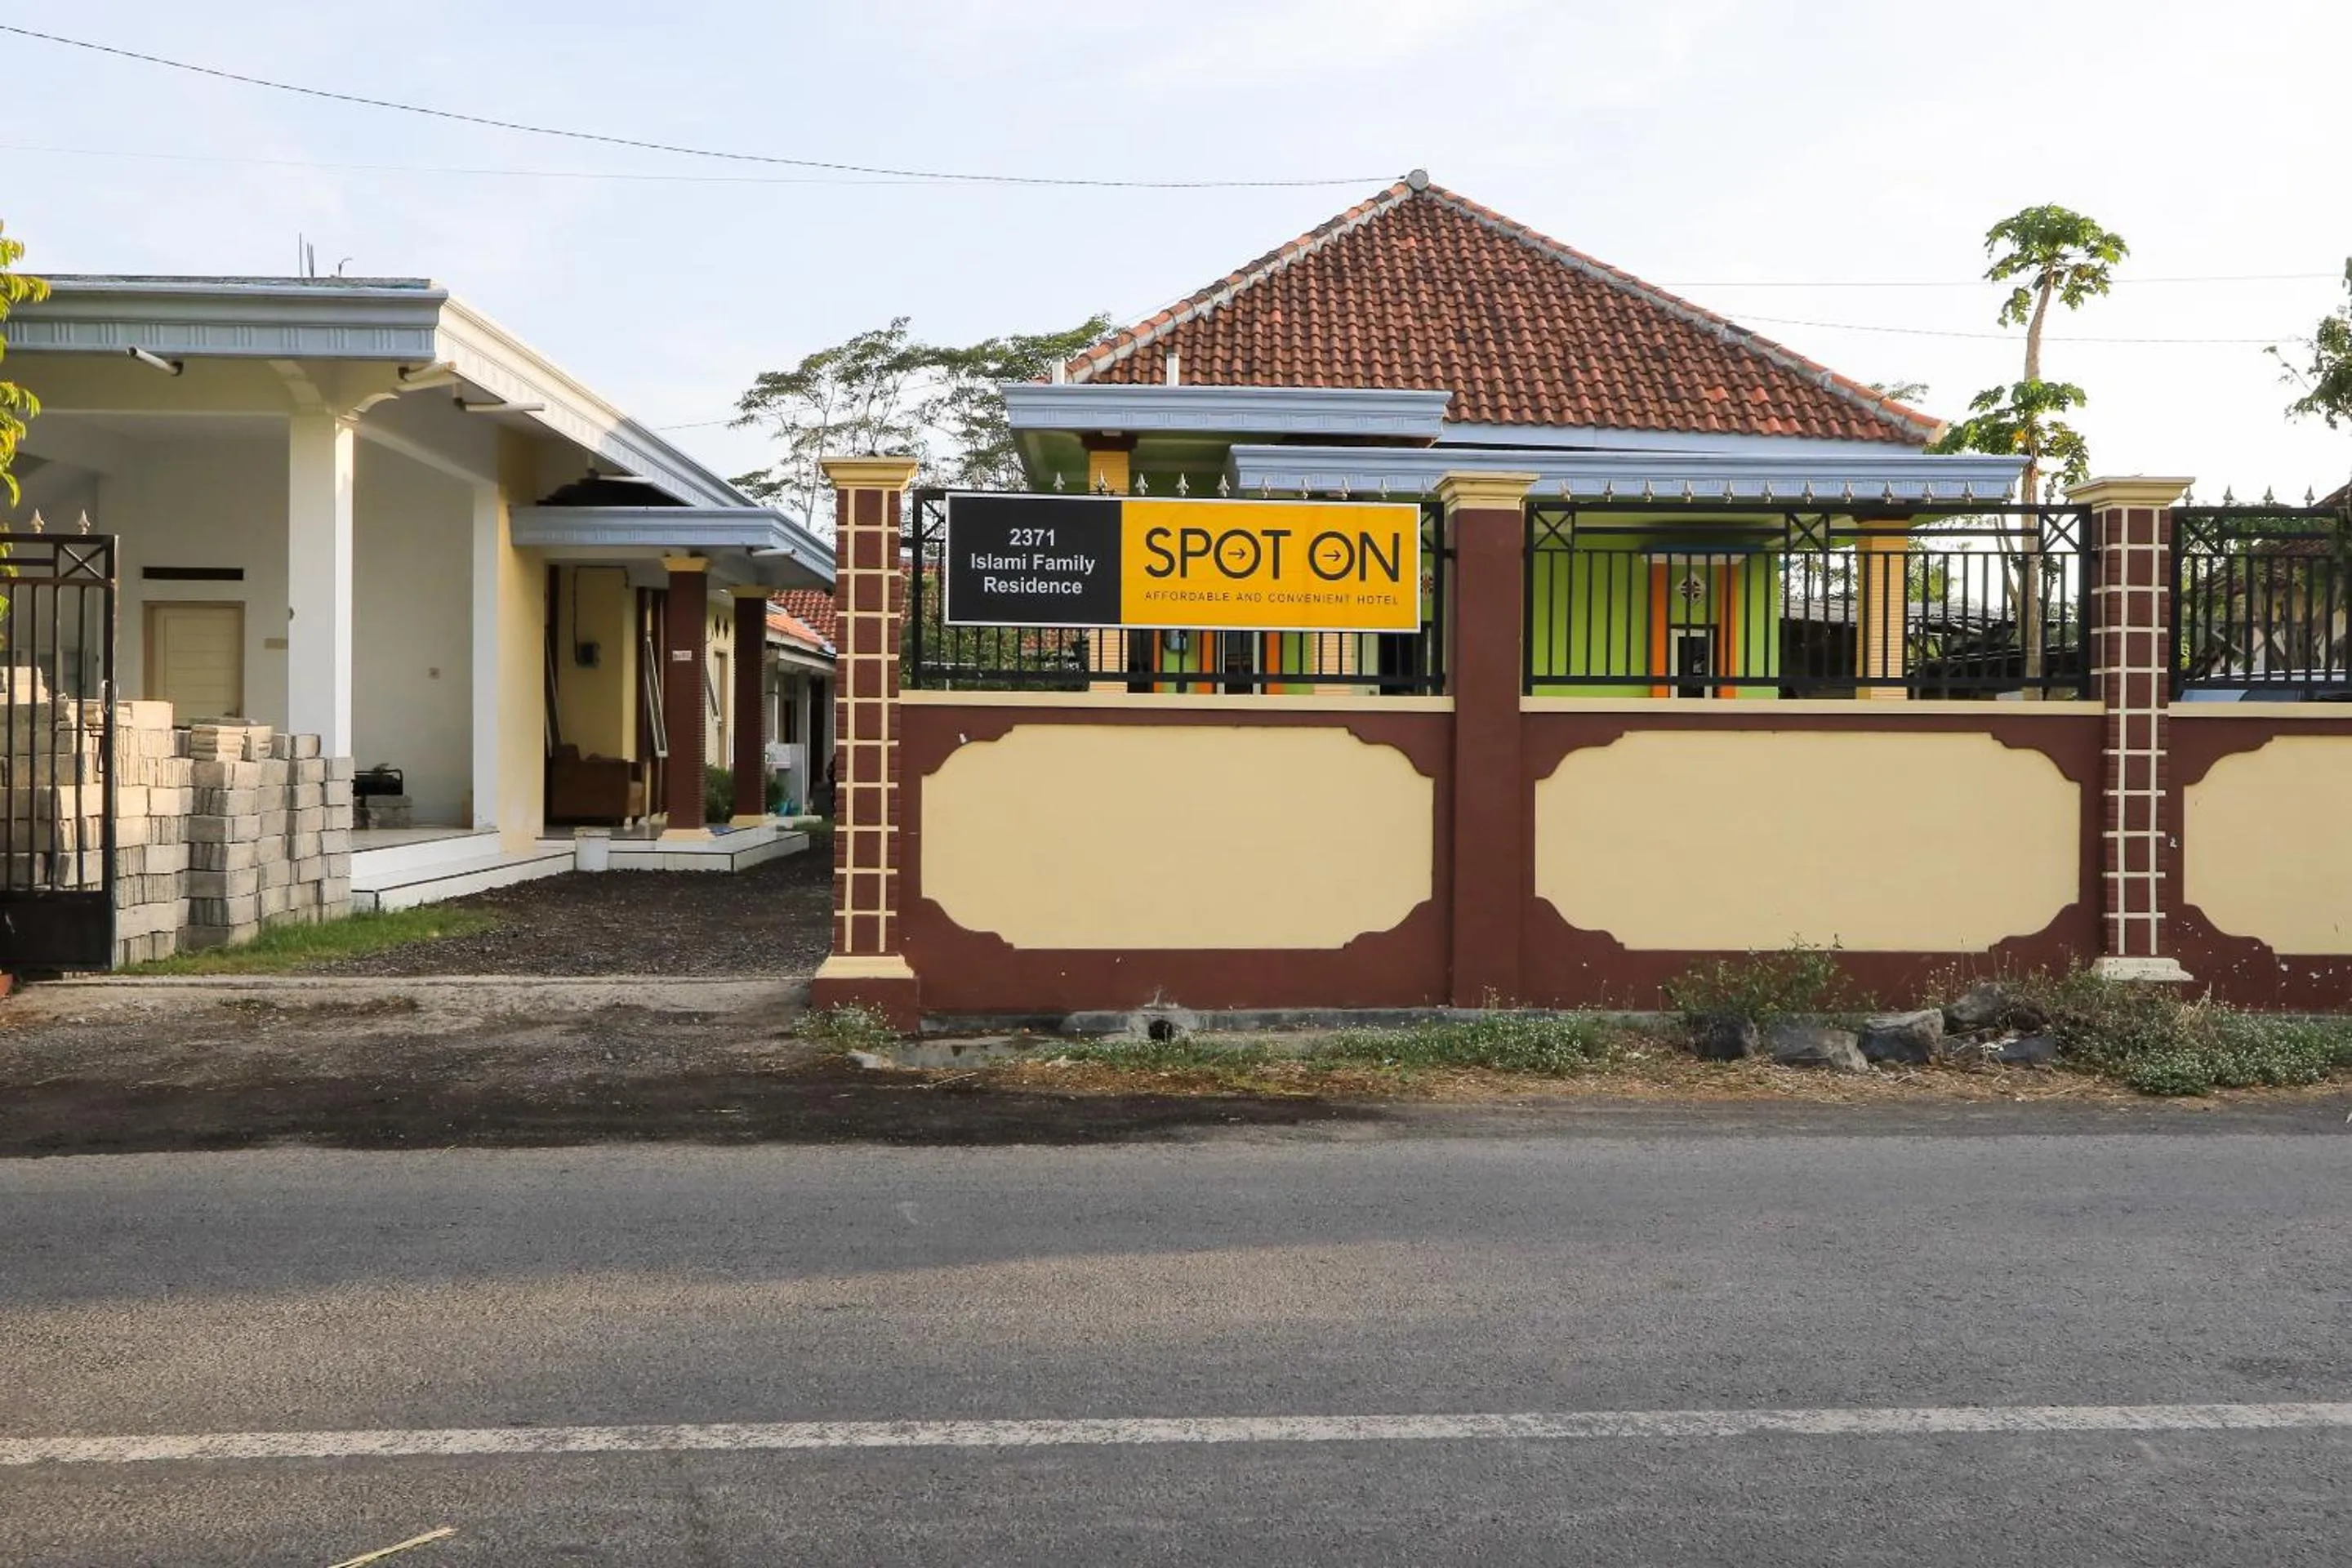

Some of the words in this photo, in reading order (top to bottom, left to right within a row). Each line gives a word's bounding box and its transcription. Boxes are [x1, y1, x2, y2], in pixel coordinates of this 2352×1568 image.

[1009, 528, 1055, 546] 2371
[1144, 527, 1291, 579] SPOT
[1307, 531, 1400, 582] ON
[970, 553, 1027, 569] Islami
[1033, 555, 1095, 575] Family
[984, 577, 1083, 595] Residence
[1145, 590, 1230, 601] AFFORDABLE
[1236, 592, 1262, 603] AND
[1267, 593, 1350, 604] CONVENIENT
[1357, 595, 1399, 605] HOTEL
